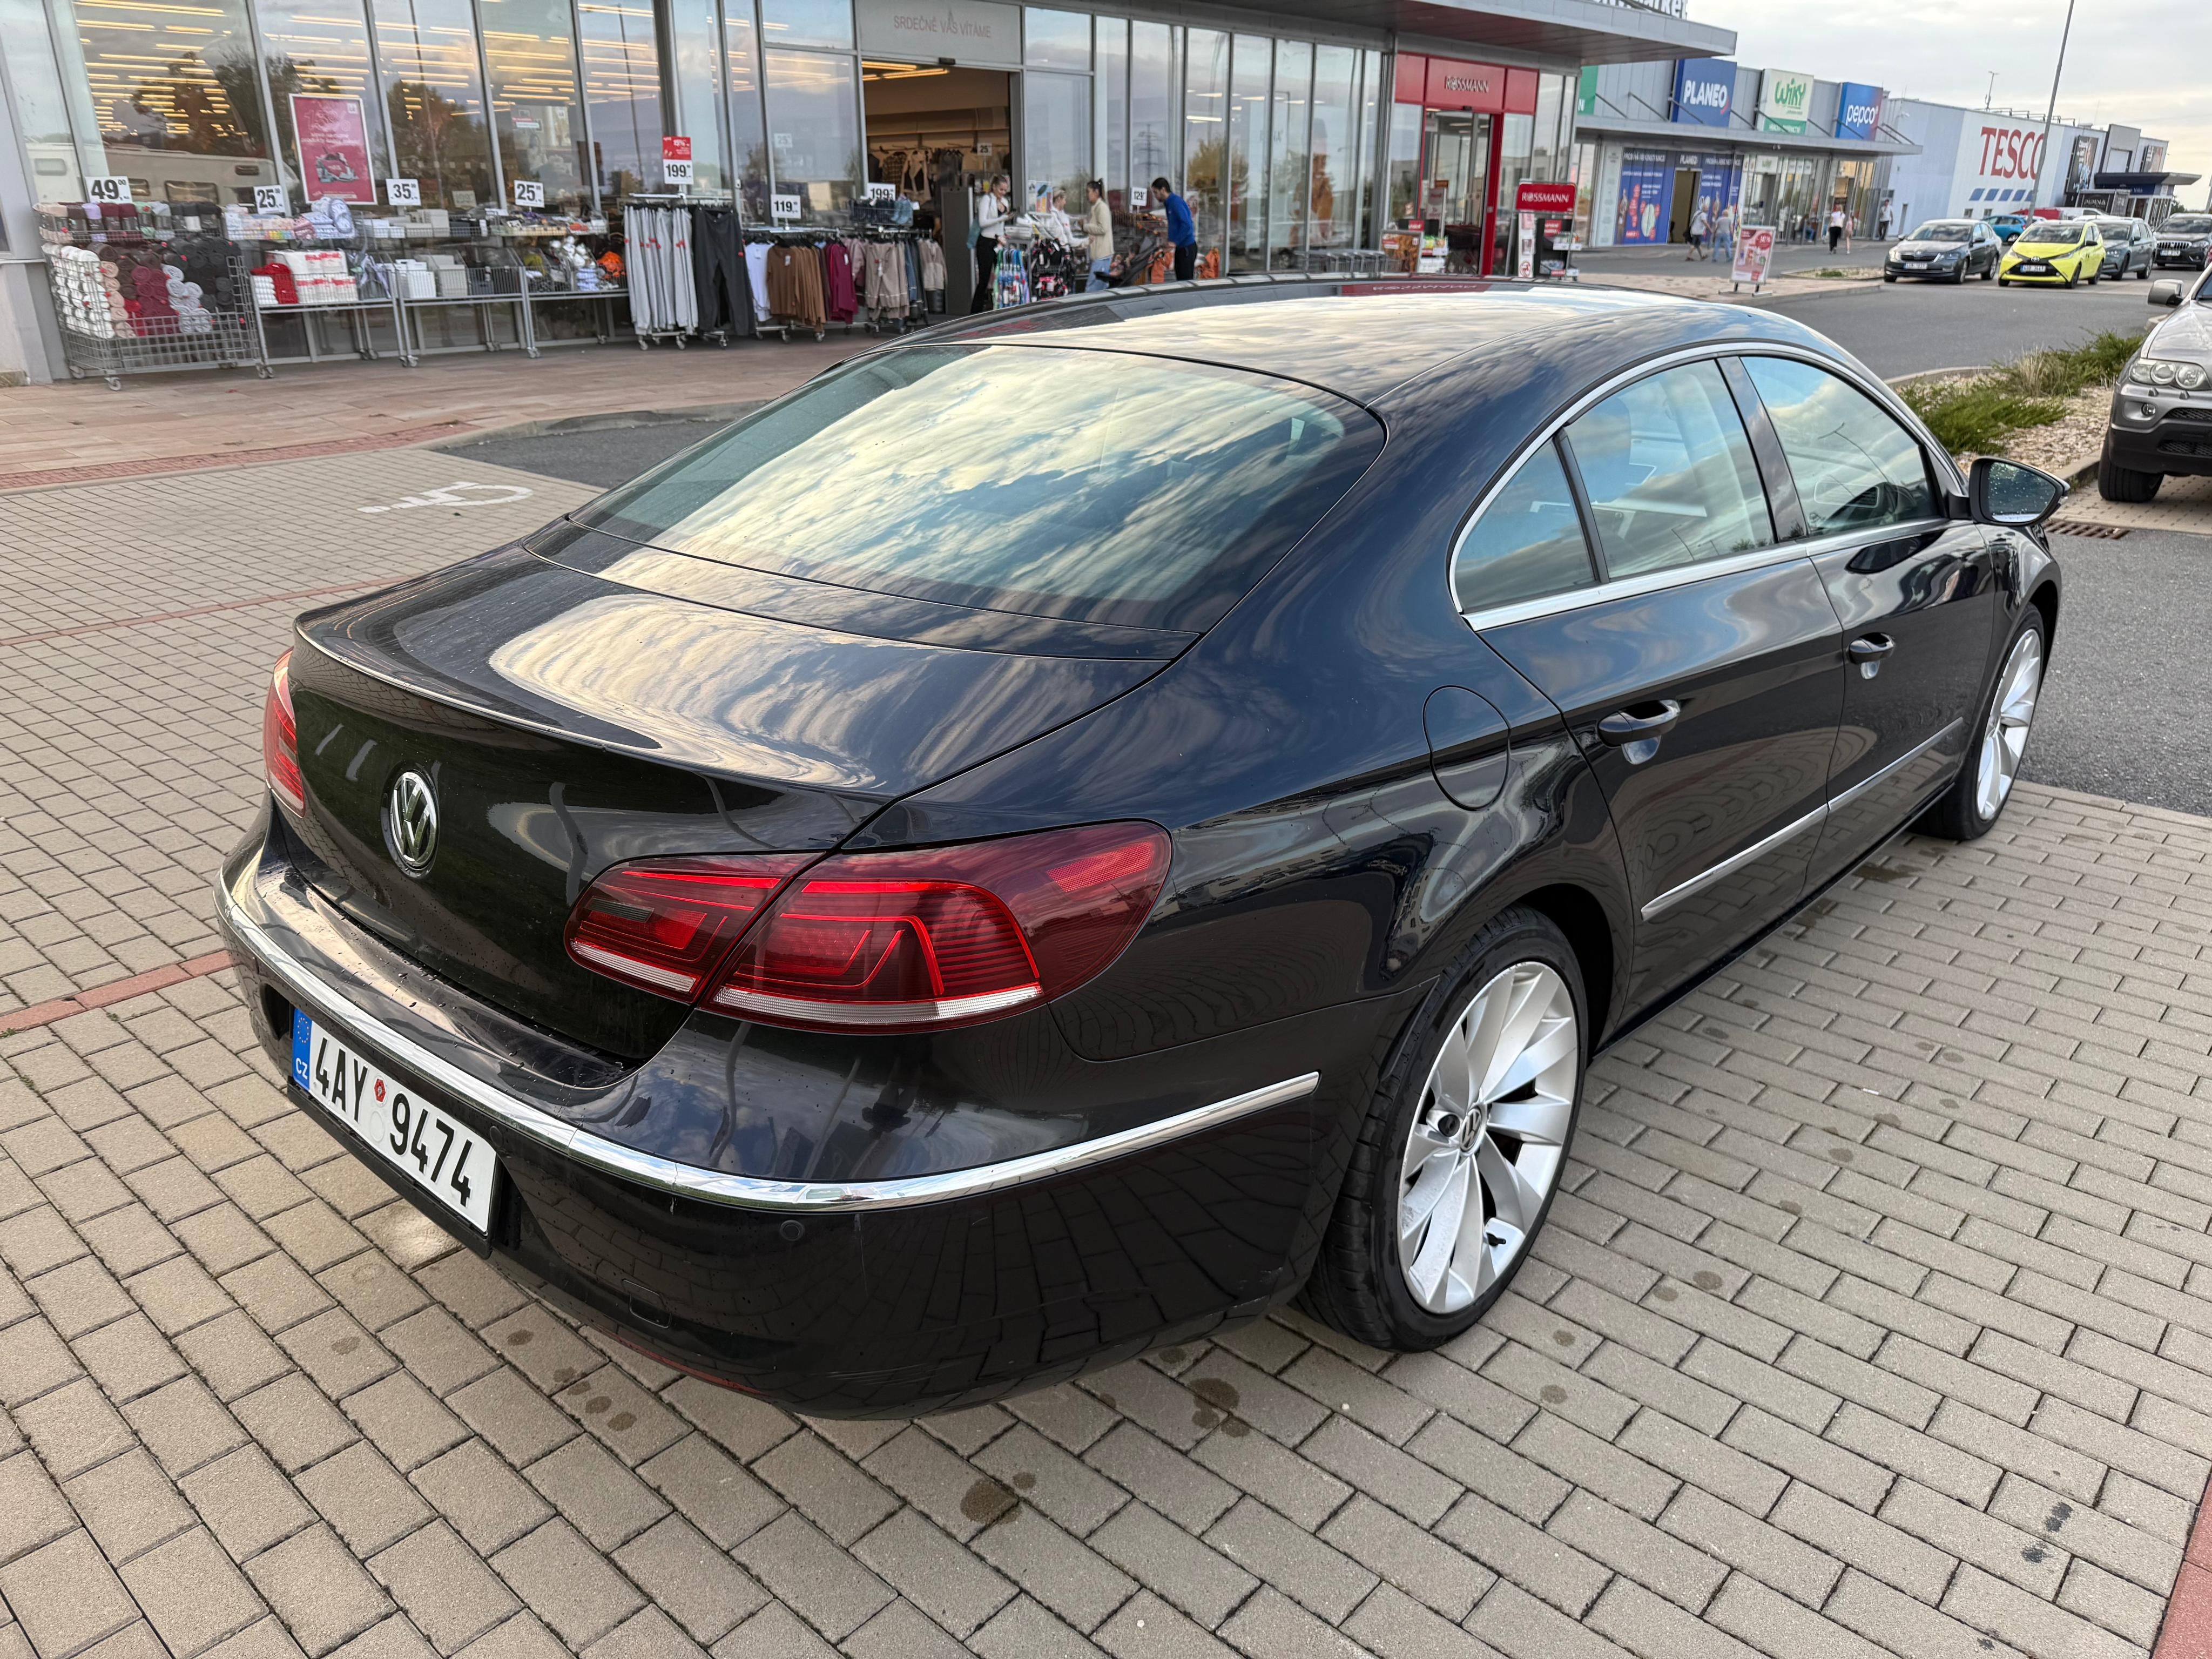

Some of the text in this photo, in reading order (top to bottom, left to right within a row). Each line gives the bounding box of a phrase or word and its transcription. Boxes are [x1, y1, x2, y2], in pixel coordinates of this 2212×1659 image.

[894, 15, 938, 32] SRDEČNĚ
[959, 19, 992, 38] VÍTÁME
[1446, 76, 1489, 93] ROSSMANN
[1683, 79, 1728, 108] PLANEO
[1845, 104, 1876, 127] pepco
[666, 164, 686, 177] 199
[91, 179, 119, 200] 49
[257, 189, 276, 208] 25
[393, 183, 412, 199] 35
[517, 184, 536, 201] 25
[1521, 192, 1569, 203] ROSSMANN
[774, 200, 792, 212] 119
[295, 1057, 308, 1080] CZ
[315, 1037, 473, 1208] 4AY 9474
